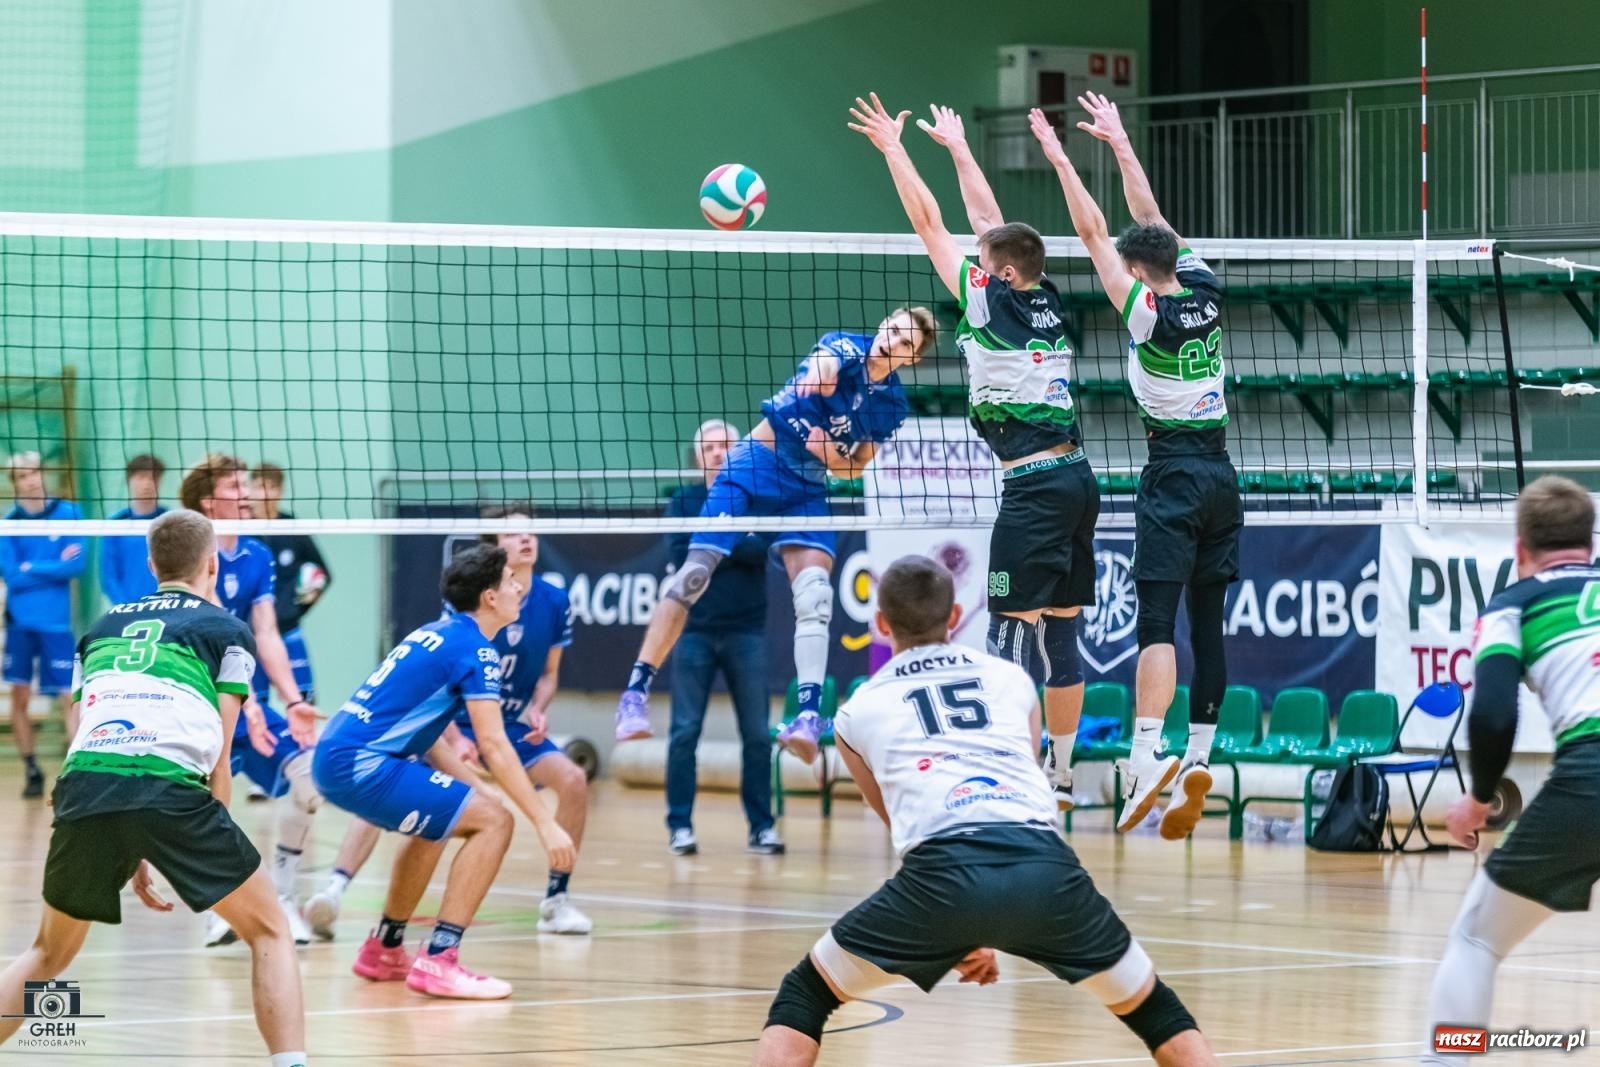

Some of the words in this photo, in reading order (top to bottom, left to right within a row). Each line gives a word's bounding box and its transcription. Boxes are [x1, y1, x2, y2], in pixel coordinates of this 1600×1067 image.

[1467, 245, 1489, 253] netex
[1178, 326, 1222, 381] 23
[881, 439, 990, 462] PIVEXIN
[882, 465, 990, 480] TECHNOLOGY
[988, 571, 1009, 596] 99
[183, 600, 202, 609] M
[113, 618, 166, 673] 3
[903, 678, 992, 739] 15
